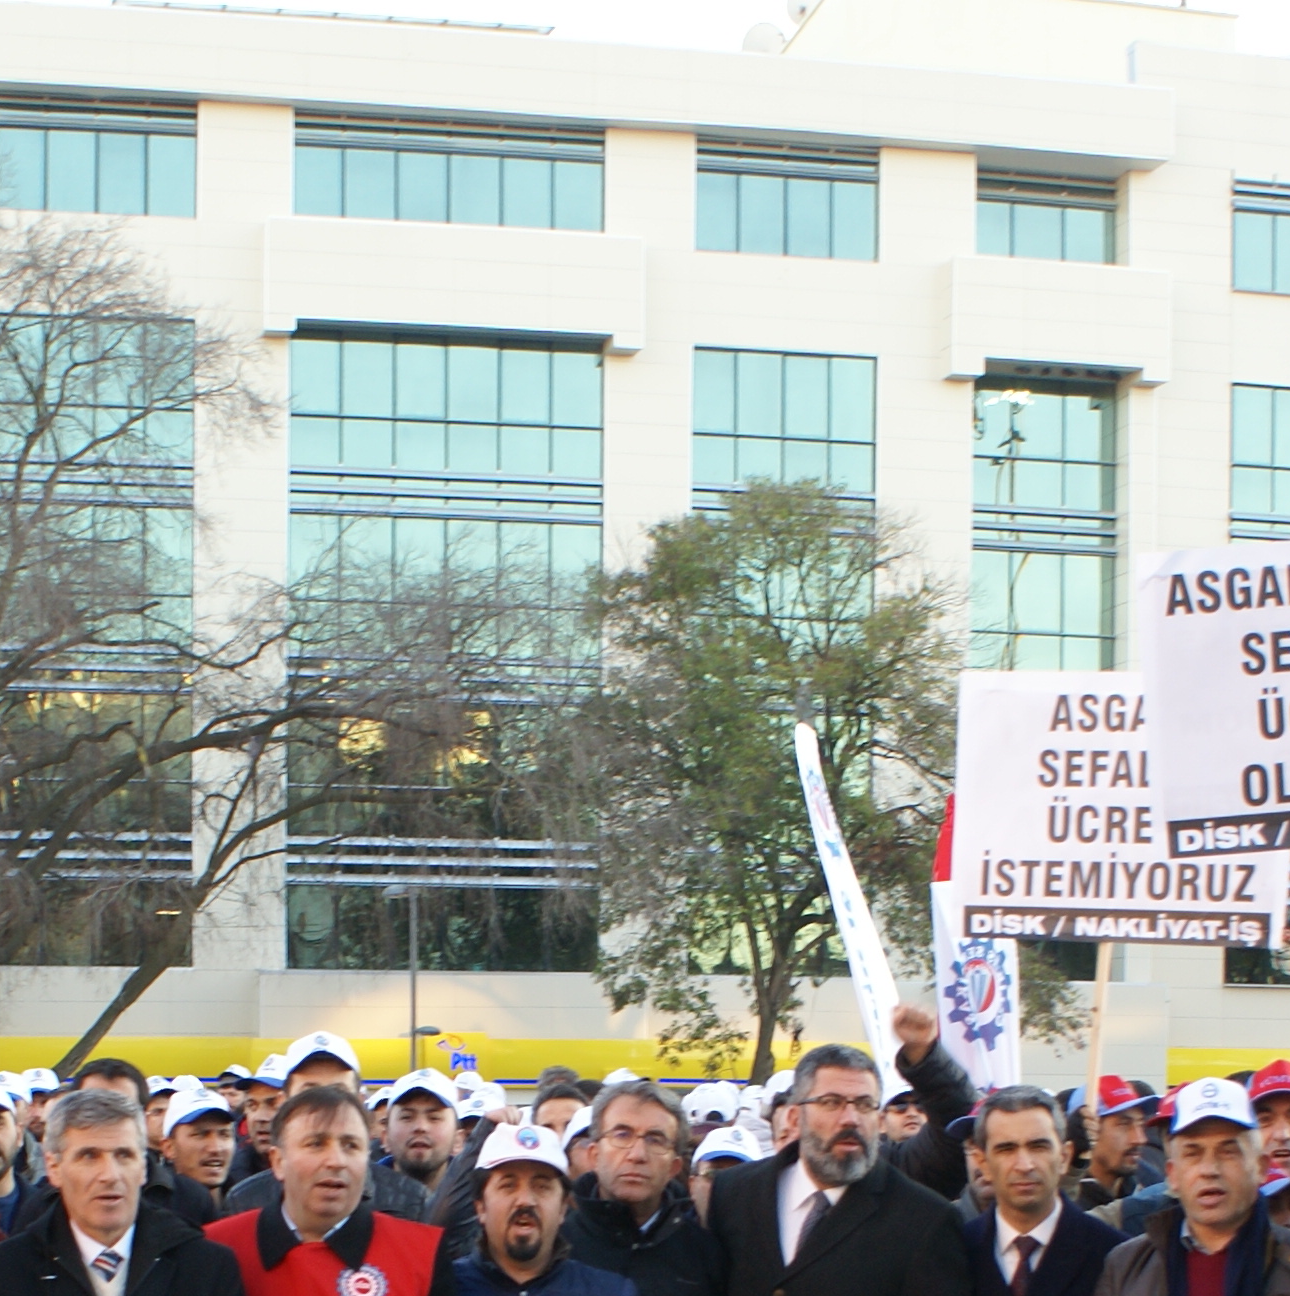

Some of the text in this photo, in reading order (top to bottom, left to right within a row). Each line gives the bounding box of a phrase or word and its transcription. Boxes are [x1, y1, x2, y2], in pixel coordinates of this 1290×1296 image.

[1049, 693, 1145, 733] ASGA
[1037, 749, 1150, 788] SEFAL
[1048, 796, 1153, 843] ÜCRE
[1177, 822, 1267, 854] DİSK
[1274, 820, 1289, 846] /
[979, 850, 1257, 903] İSTEMİYORUZ
[970, 909, 1263, 947] DİSK / NAKLİYAT-İŞ
